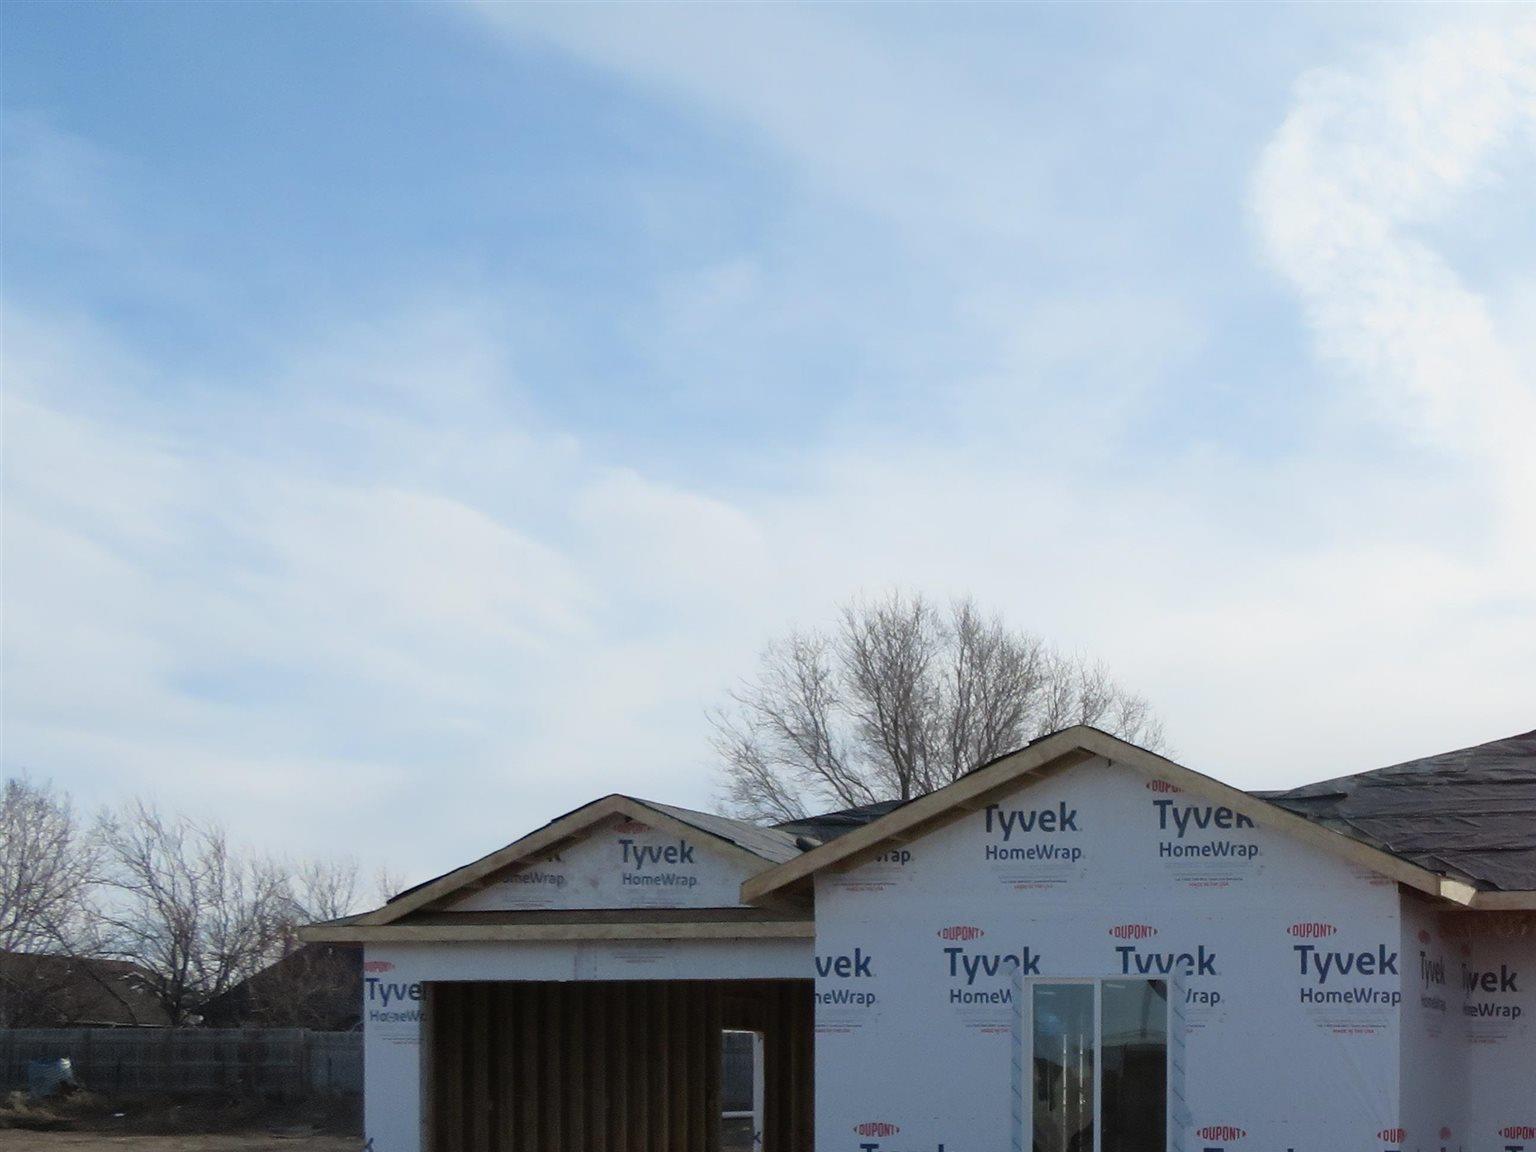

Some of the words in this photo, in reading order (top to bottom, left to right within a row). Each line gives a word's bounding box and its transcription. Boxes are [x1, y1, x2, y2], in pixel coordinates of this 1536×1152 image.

[985, 802, 1079, 841] Tyvek
[1153, 800, 1254, 838] Tyvek
[619, 839, 694, 870] Tyvek
[985, 845, 1082, 862] HomeWrap
[1160, 841, 1259, 860] HomeWrap
[622, 872, 697, 888] HomeWrap
[941, 926, 980, 940] DUPONT
[1114, 924, 1153, 939] DUPONT
[1292, 923, 1333, 938] DUPONT
[815, 948, 872, 978] vek
[1293, 944, 1399, 984] Tyvek
[365, 977, 426, 1007] Tyve
[814, 990, 876, 1007] eWrap
[950, 989, 1012, 1004] HomeW
[1300, 987, 1401, 1007] HomeWrap
[858, 1122, 896, 1137] DUPONT
[1202, 1125, 1242, 1141] DUPONT
